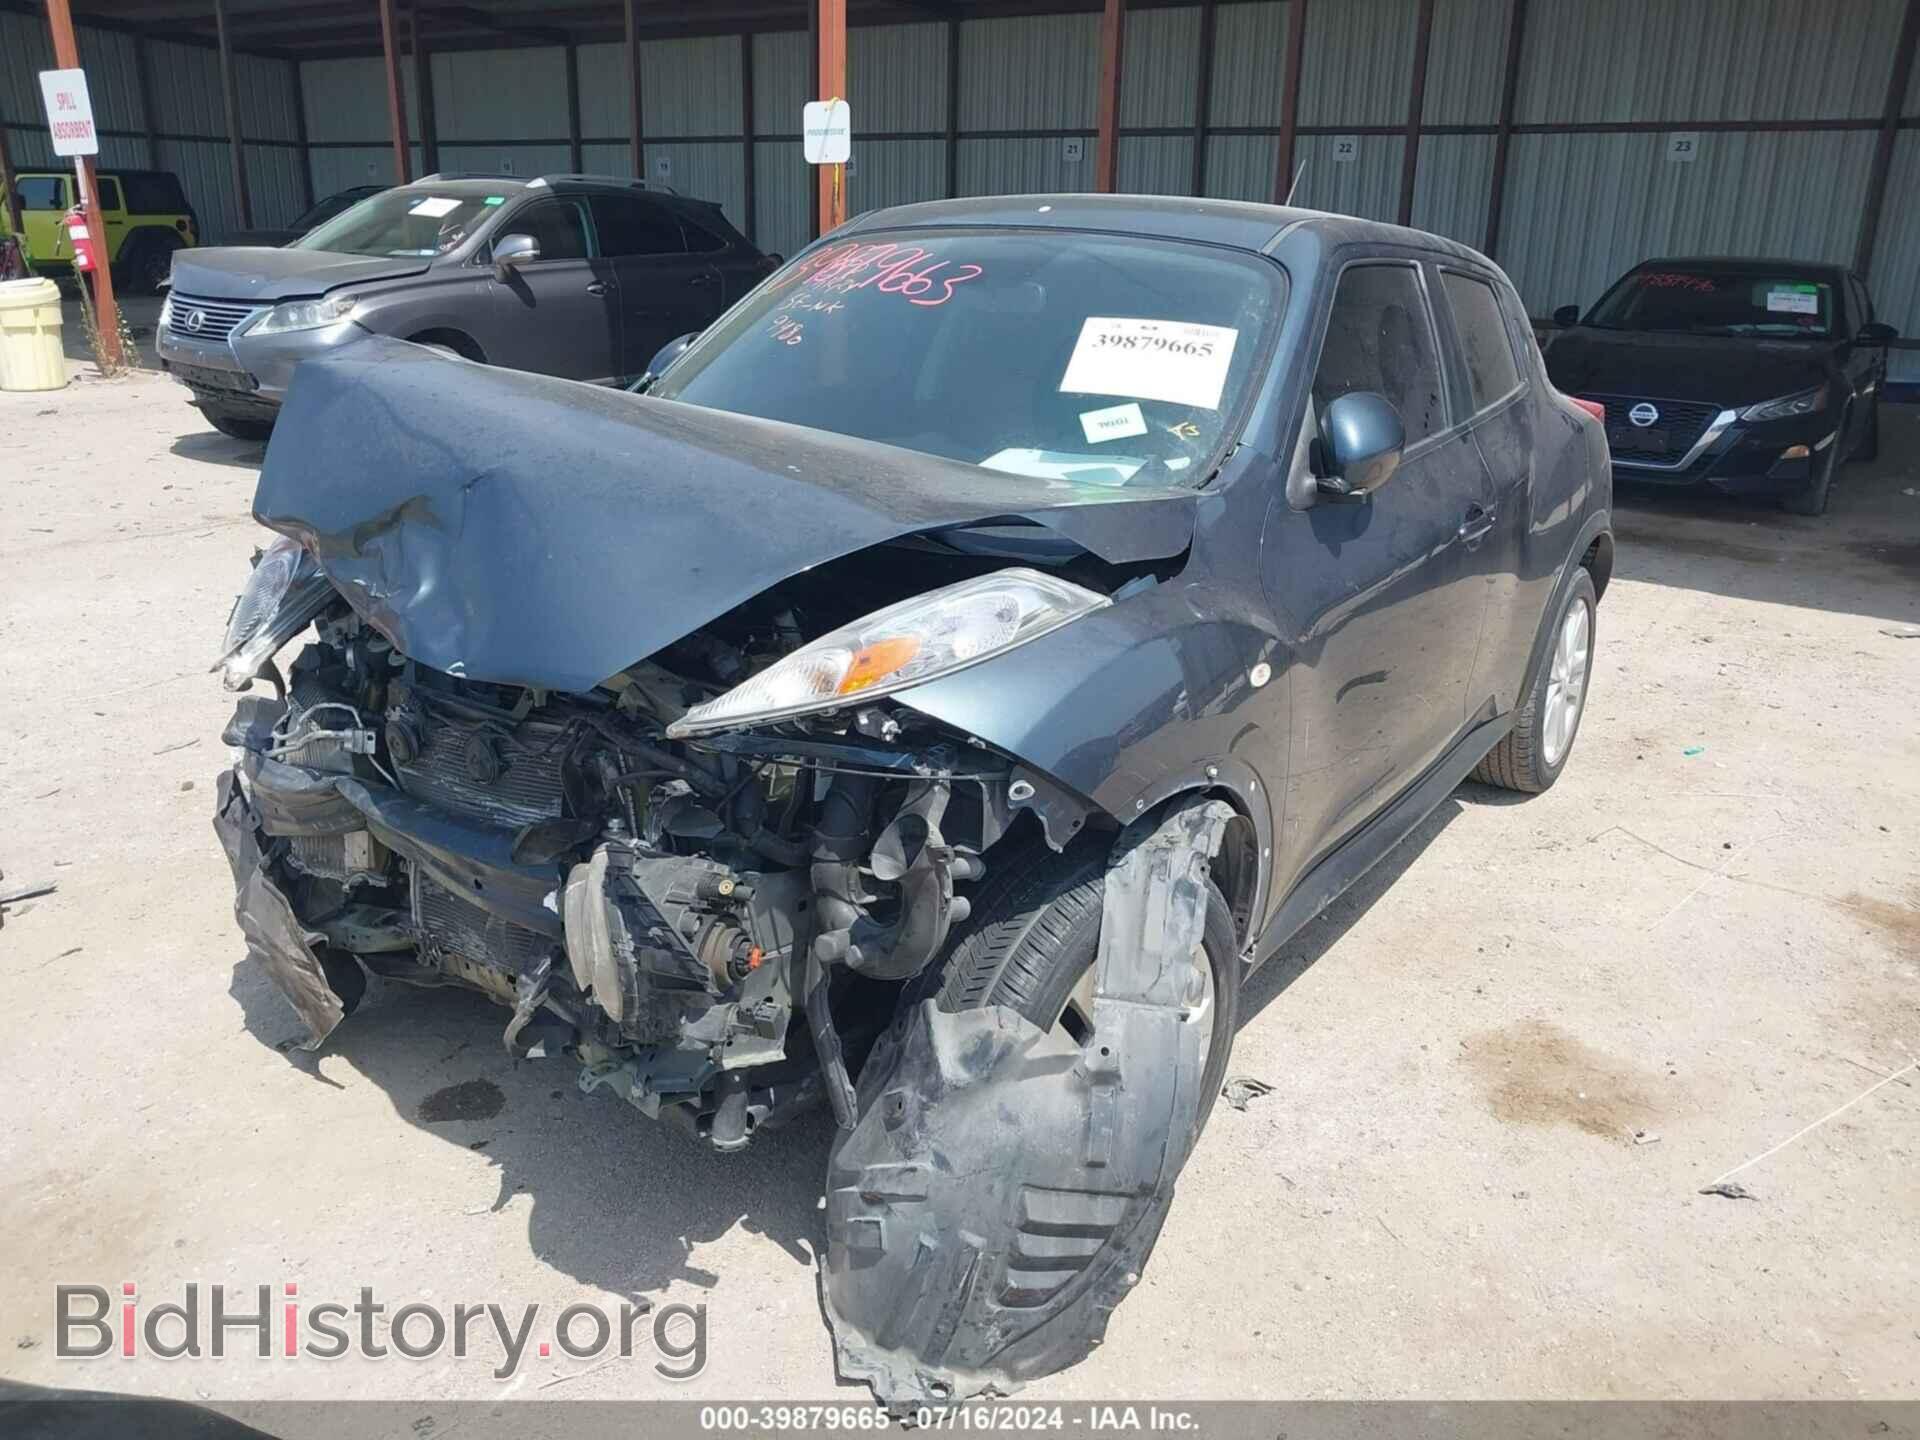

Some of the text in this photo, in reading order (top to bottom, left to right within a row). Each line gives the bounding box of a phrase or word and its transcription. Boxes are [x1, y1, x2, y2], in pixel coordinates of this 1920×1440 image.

[1067, 144, 1078, 154] 21
[1339, 143, 1352, 153] 22
[1675, 140, 1691, 151] 23
[1091, 333, 1214, 357] 39879665
